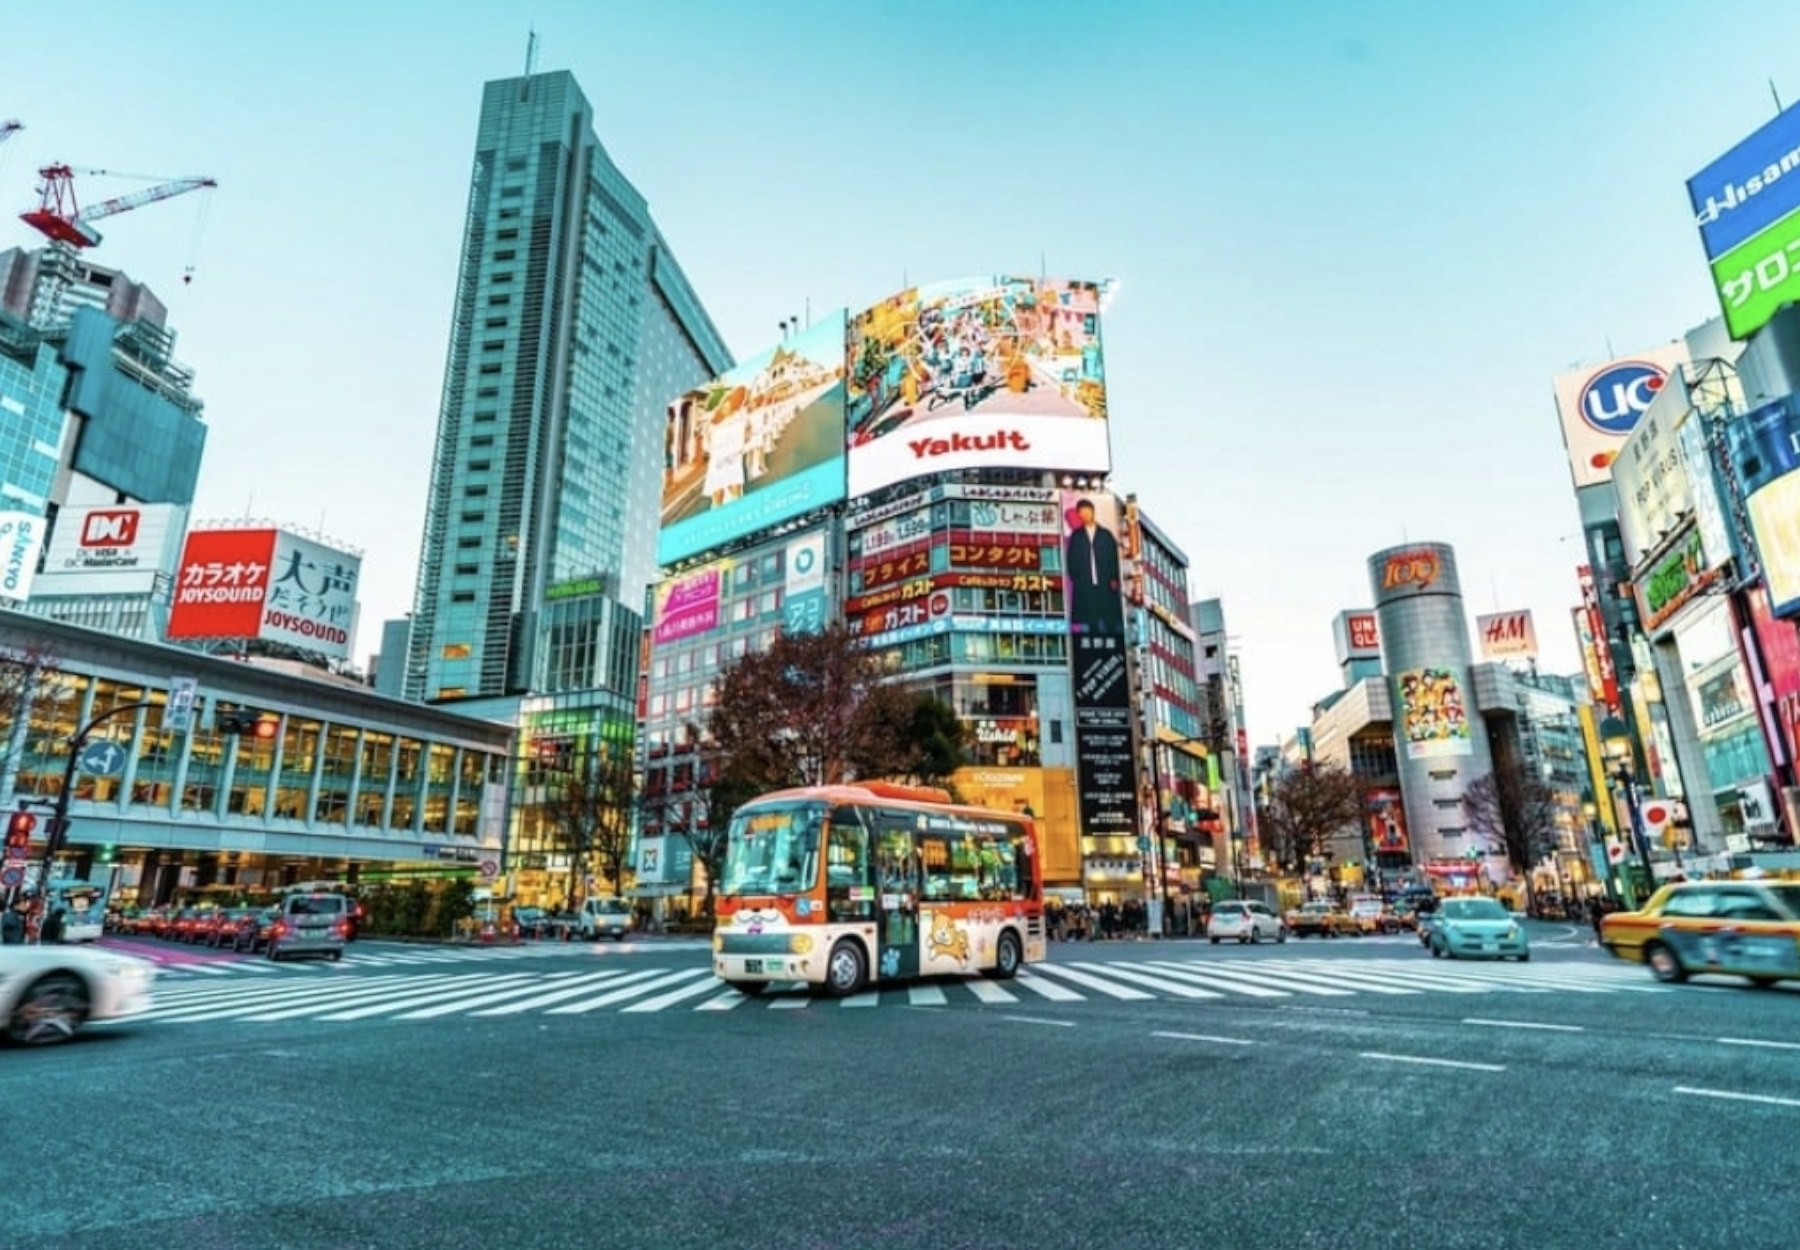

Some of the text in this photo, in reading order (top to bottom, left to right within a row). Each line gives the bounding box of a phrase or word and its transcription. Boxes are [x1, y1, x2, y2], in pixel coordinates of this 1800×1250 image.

[908, 430, 1031, 460] Yakult
[3, 521, 33, 590] SANKYO
[864, 552, 928, 584] プライス
[950, 546, 1037, 564] コンタクト
[183, 562, 266, 585] カラオケ
[274, 549, 356, 596] 大声
[1013, 574, 1055, 591] ガスト
[1383, 551, 1441, 590] 109
[178, 586, 264, 604] JOYSOUND
[902, 579, 935, 600] ガスト
[264, 609, 348, 644] JOYSOUND
[885, 602, 926, 630] ガスト
[1486, 615, 1525, 642] H&M
